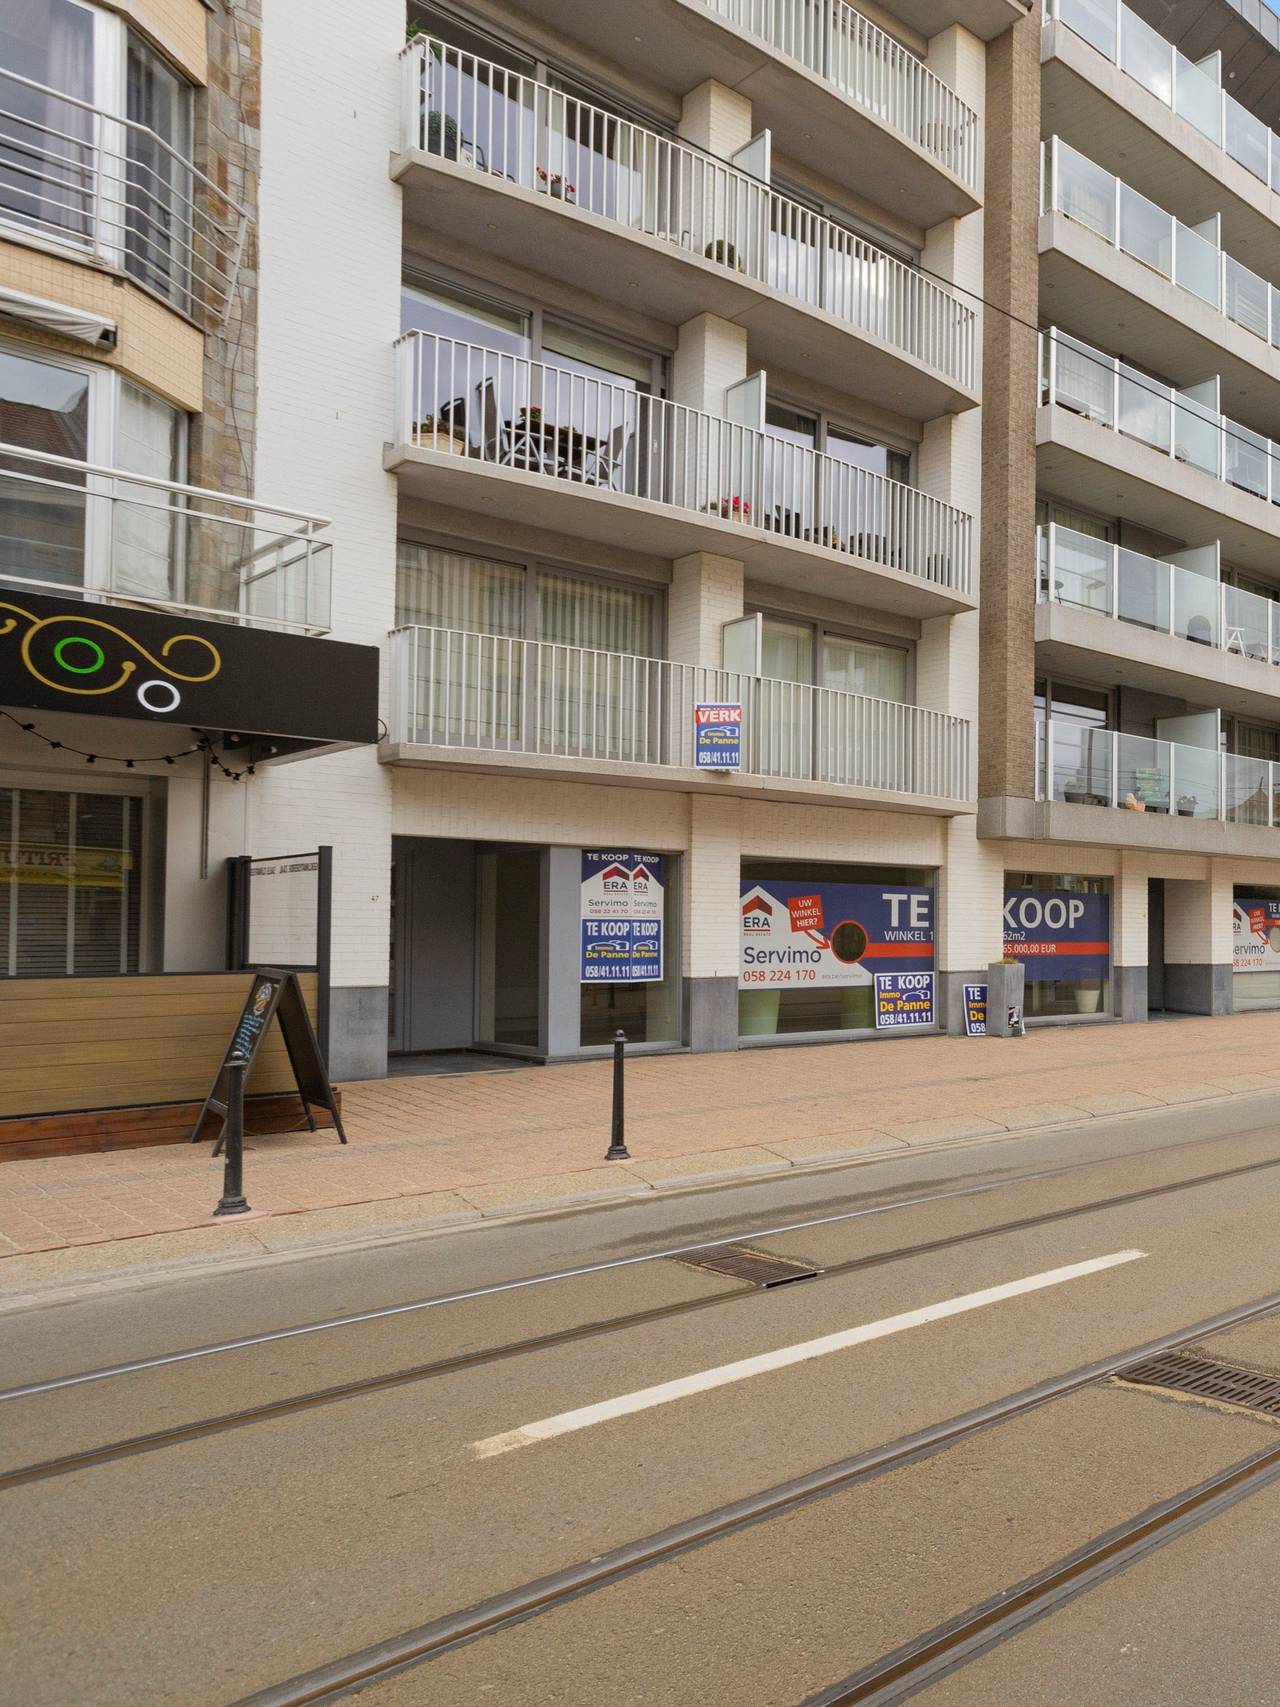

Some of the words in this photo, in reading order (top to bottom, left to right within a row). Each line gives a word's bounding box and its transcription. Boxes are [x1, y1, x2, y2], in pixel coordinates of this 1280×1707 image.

[698, 709, 741, 723] VERK
[698, 751, 739, 764] 058/41.11.11
[586, 853, 599, 861] TE
[601, 853, 629, 861] KOOP
[633, 854, 642, 862] TE
[603, 881, 629, 890] ERA
[633, 882, 649, 890] ERA
[588, 899, 629, 907] Servimo
[798, 899, 813, 908] UW
[1269, 903, 1277, 913] TE
[791, 908, 821, 918] WINKEL
[882, 893, 930, 928] TE
[1003, 897, 1085, 929] KOOP
[743, 917, 771, 928] ERA
[796, 918, 818, 927] HIER?
[1233, 922, 1242, 931] RA
[586, 922, 599, 936] TE
[601, 922, 630, 936] KOOP
[632, 922, 641, 936] TE
[641, 922, 659, 936] KOOP
[884, 930, 927, 941] WINKEL
[1041, 944, 1057, 954] EUR
[1233, 941, 1266, 955] ervimo
[585, 951, 599, 959] De
[600, 951, 629, 959] Panne
[640, 950, 658, 958] Panne
[743, 945, 822, 965] Servimo
[585, 965, 630, 978] 058/41.11.11
[743, 971, 766, 982] 058
[769, 970, 792, 982] 224
[796, 969, 817, 981] 170
[879, 976, 892, 990] TE
[897, 975, 930, 989] KOOP
[880, 991, 901, 999] Immo
[968, 988, 982, 1000] TE
[880, 1002, 894, 1012] De
[897, 1000, 931, 1011] Panne
[880, 1011, 932, 1025] 058/41.11.11
[970, 1010, 985, 1021] De
